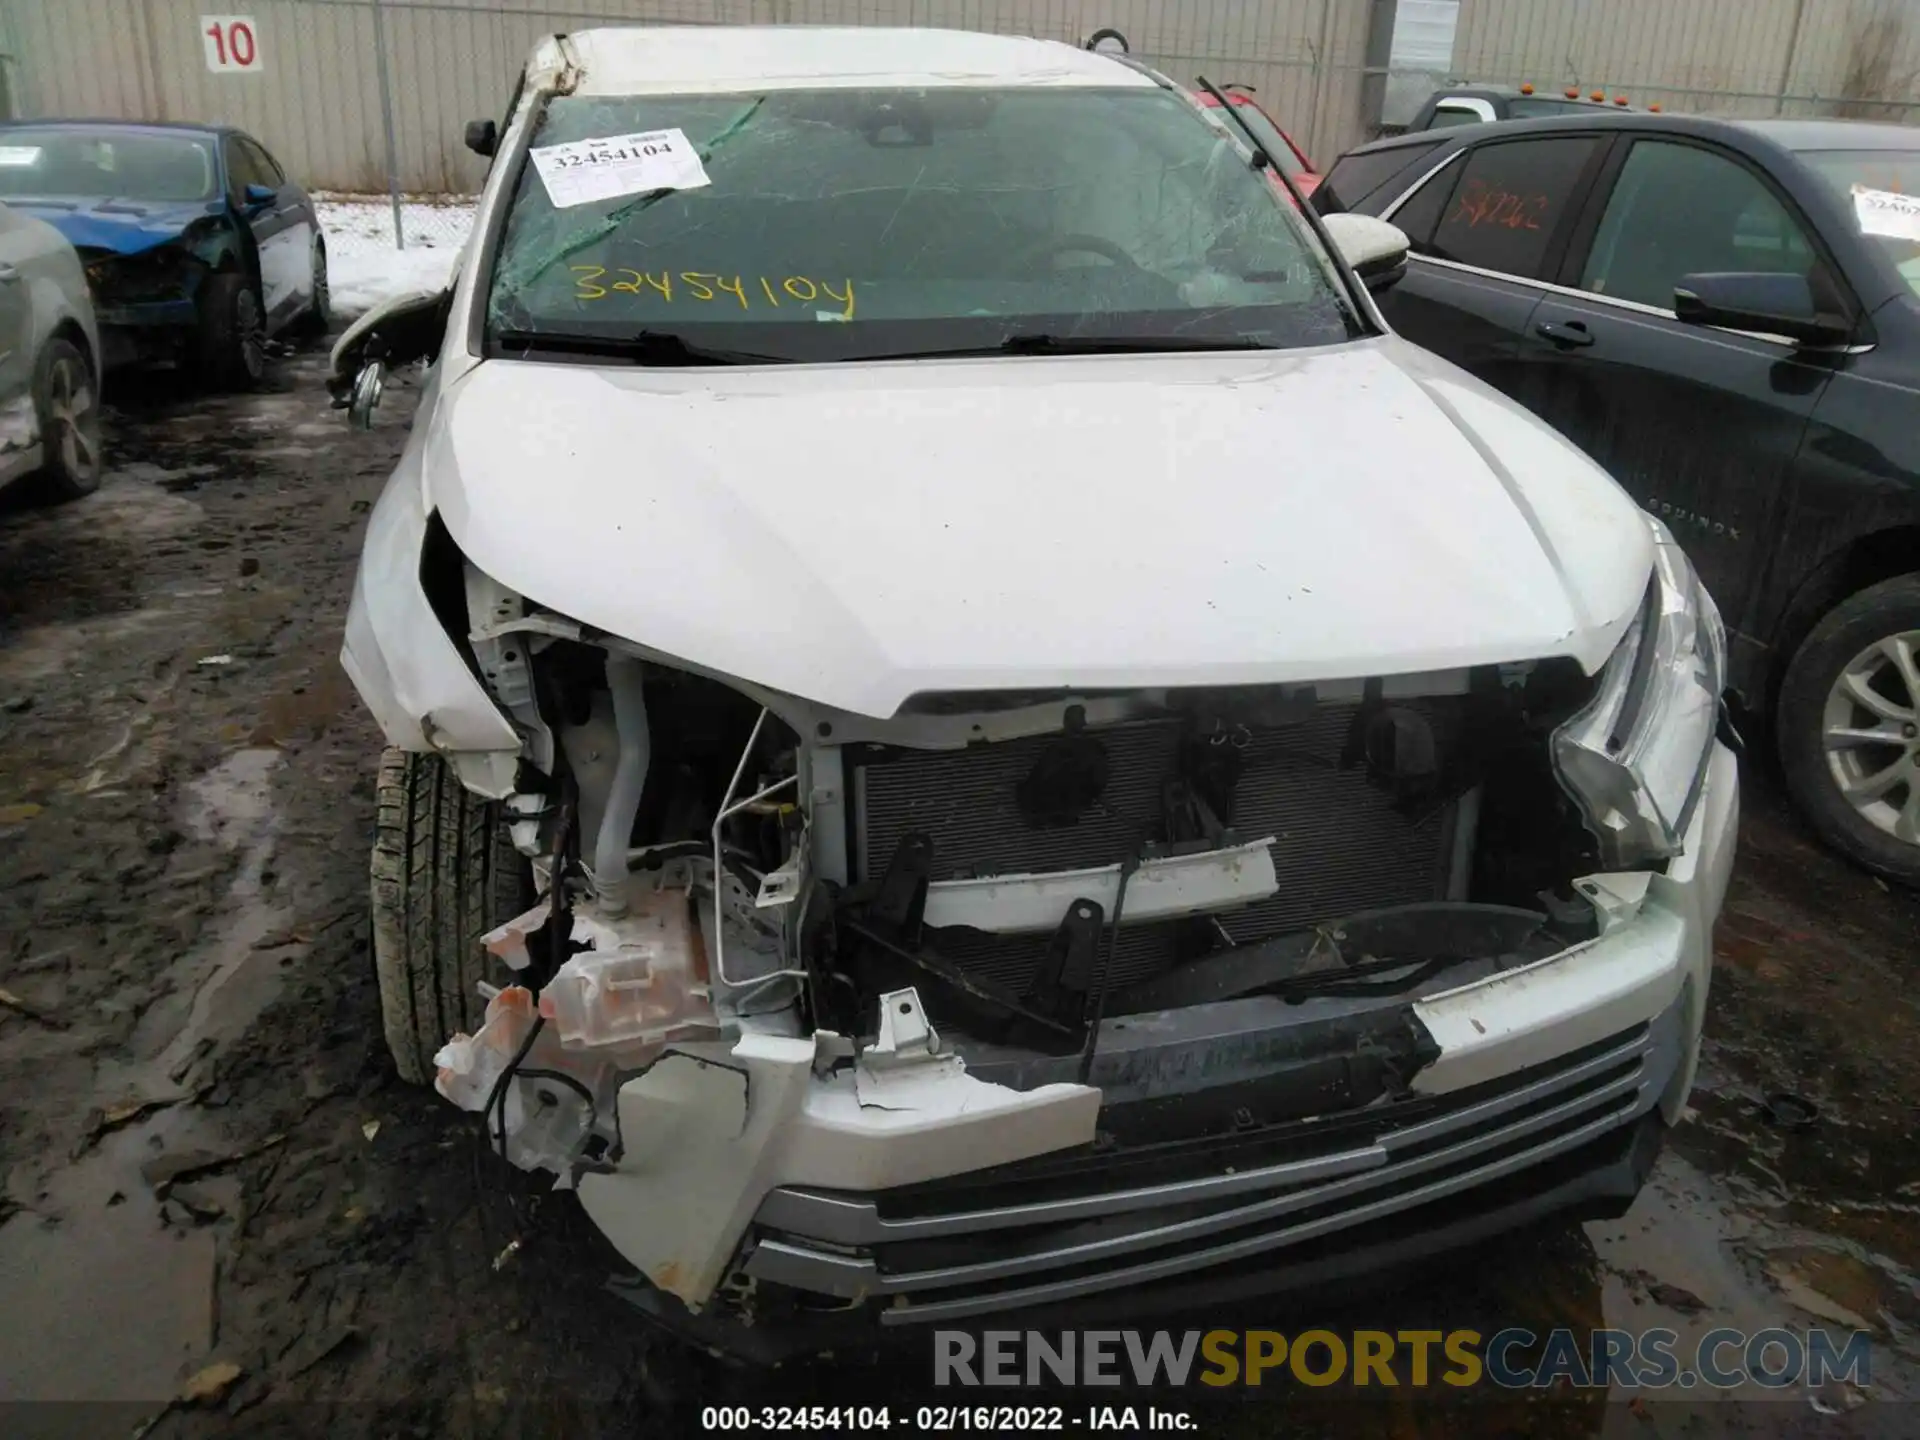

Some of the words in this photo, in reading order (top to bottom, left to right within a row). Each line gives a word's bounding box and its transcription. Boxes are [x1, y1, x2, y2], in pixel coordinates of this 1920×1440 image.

[206, 21, 254, 66] 10
[552, 143, 673, 170] 32454104
[570, 266, 853, 323] 32454104
[1649, 498, 1740, 540] EQUINOX
